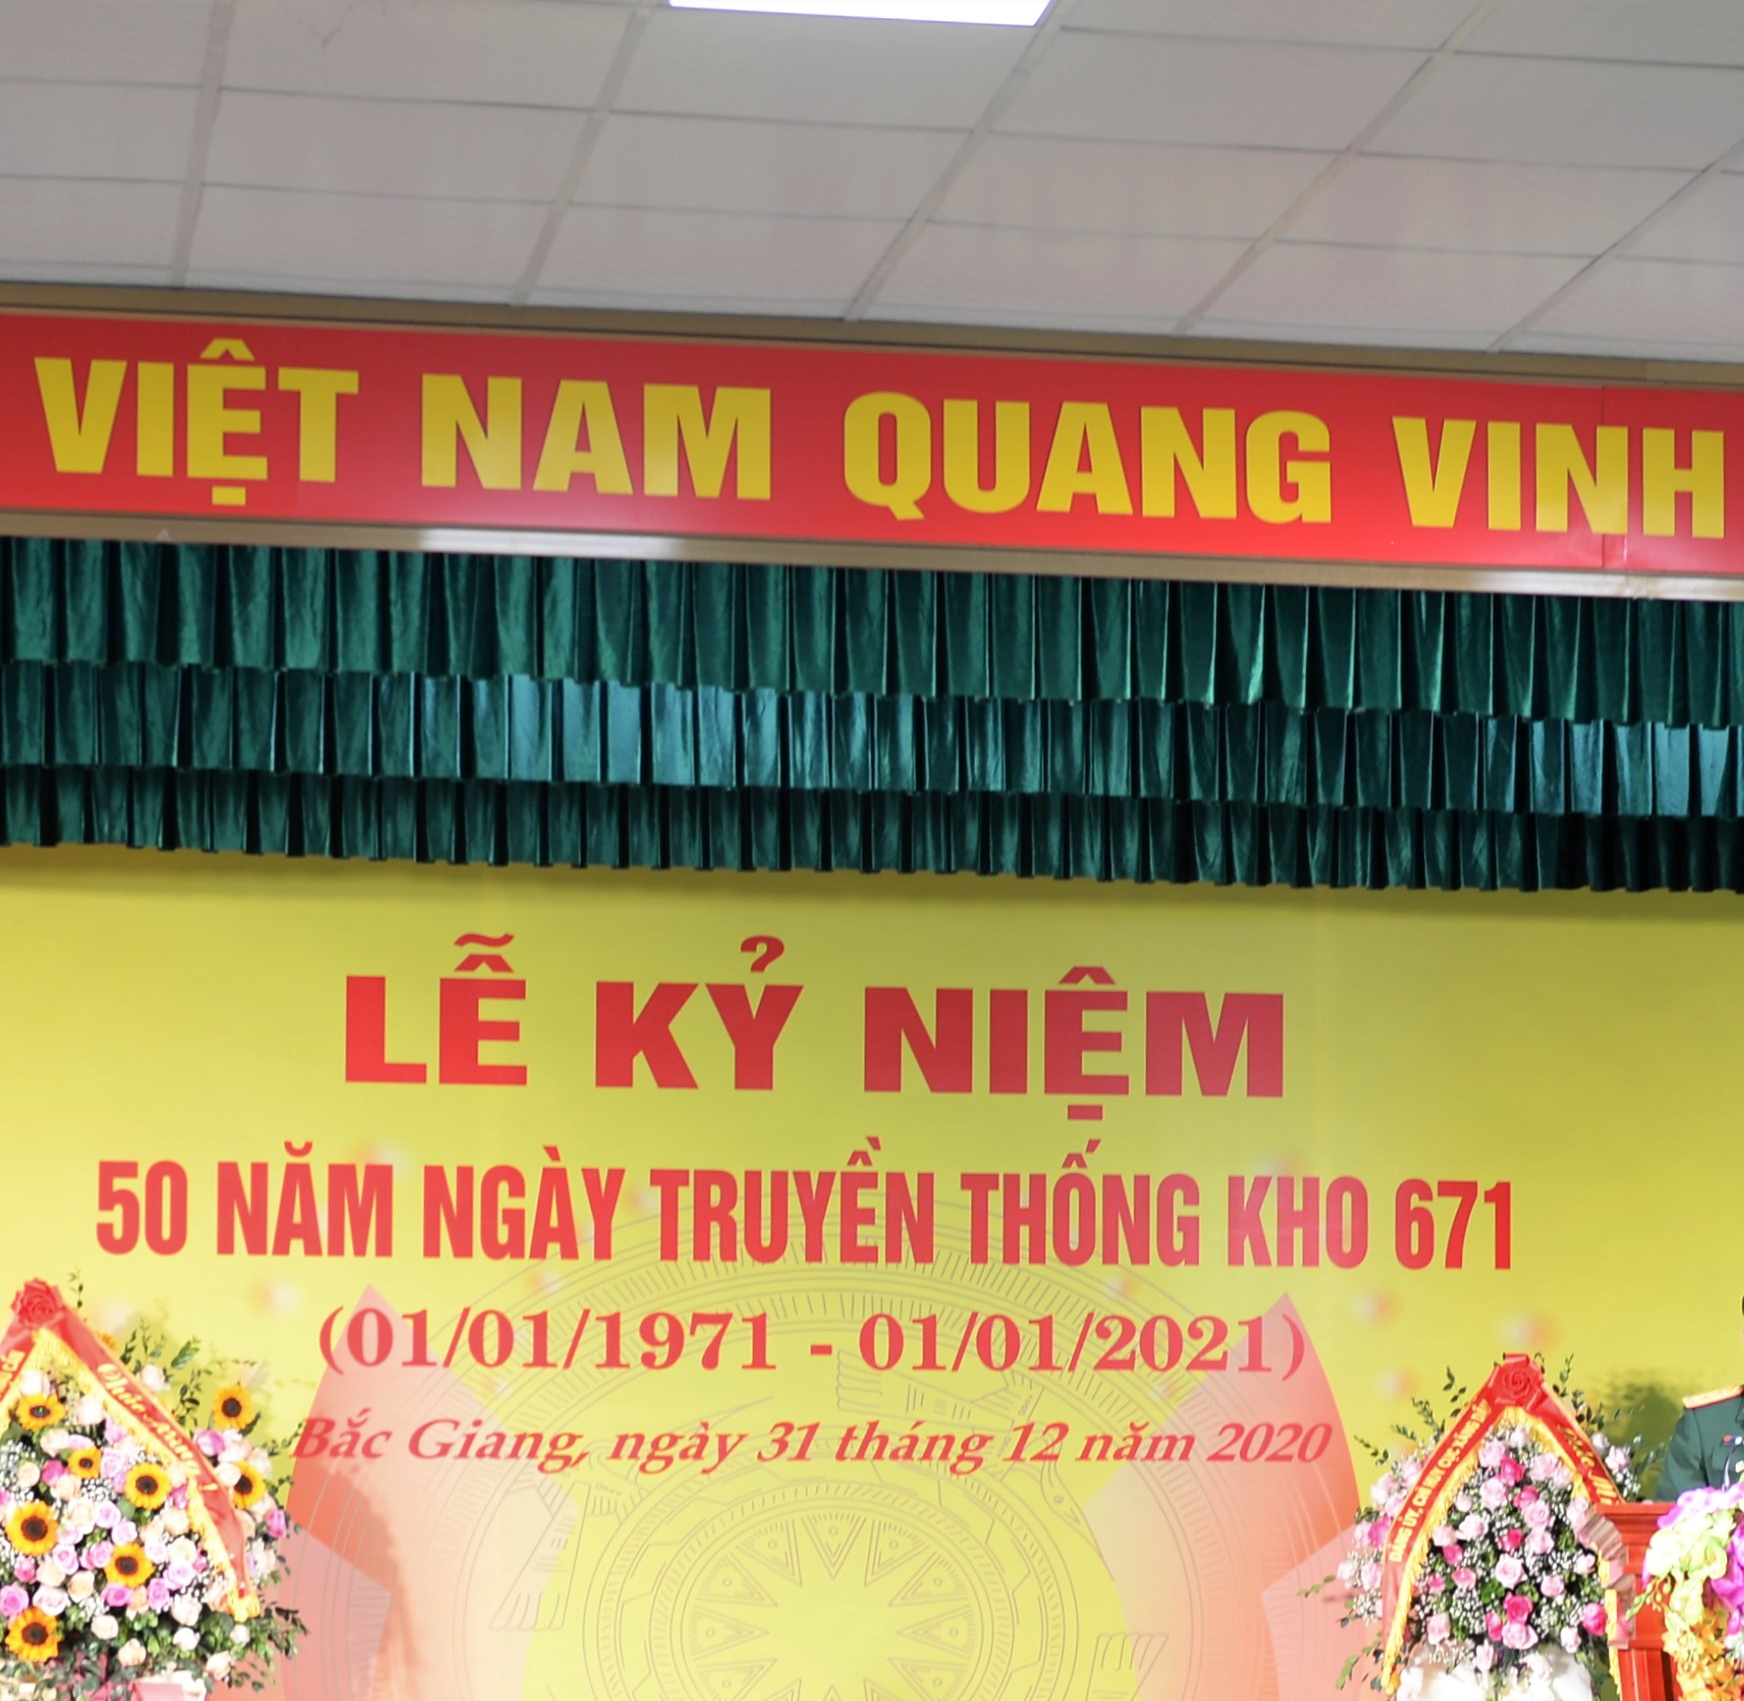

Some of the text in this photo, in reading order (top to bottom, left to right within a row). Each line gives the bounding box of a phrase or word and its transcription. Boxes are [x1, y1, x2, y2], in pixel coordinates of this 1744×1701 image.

[34, 338, 359, 505] VIỆT
[421, 373, 771, 500] NAM
[843, 391, 1332, 524] QUANG
[1392, 416, 1725, 538] VINH
[343, 933, 1287, 1122] LỄ KỶ NIỆM
[95, 1134, 1513, 1271] 50 NĂM NGÀY TRUYỀN THỐNG KHO 671
[317, 1305, 1307, 1381] (01/01/1971 - 01/01/2021)
[293, 1414, 1333, 1476] Bắc Giang, ngày 31 tháng 12 năm 2020
